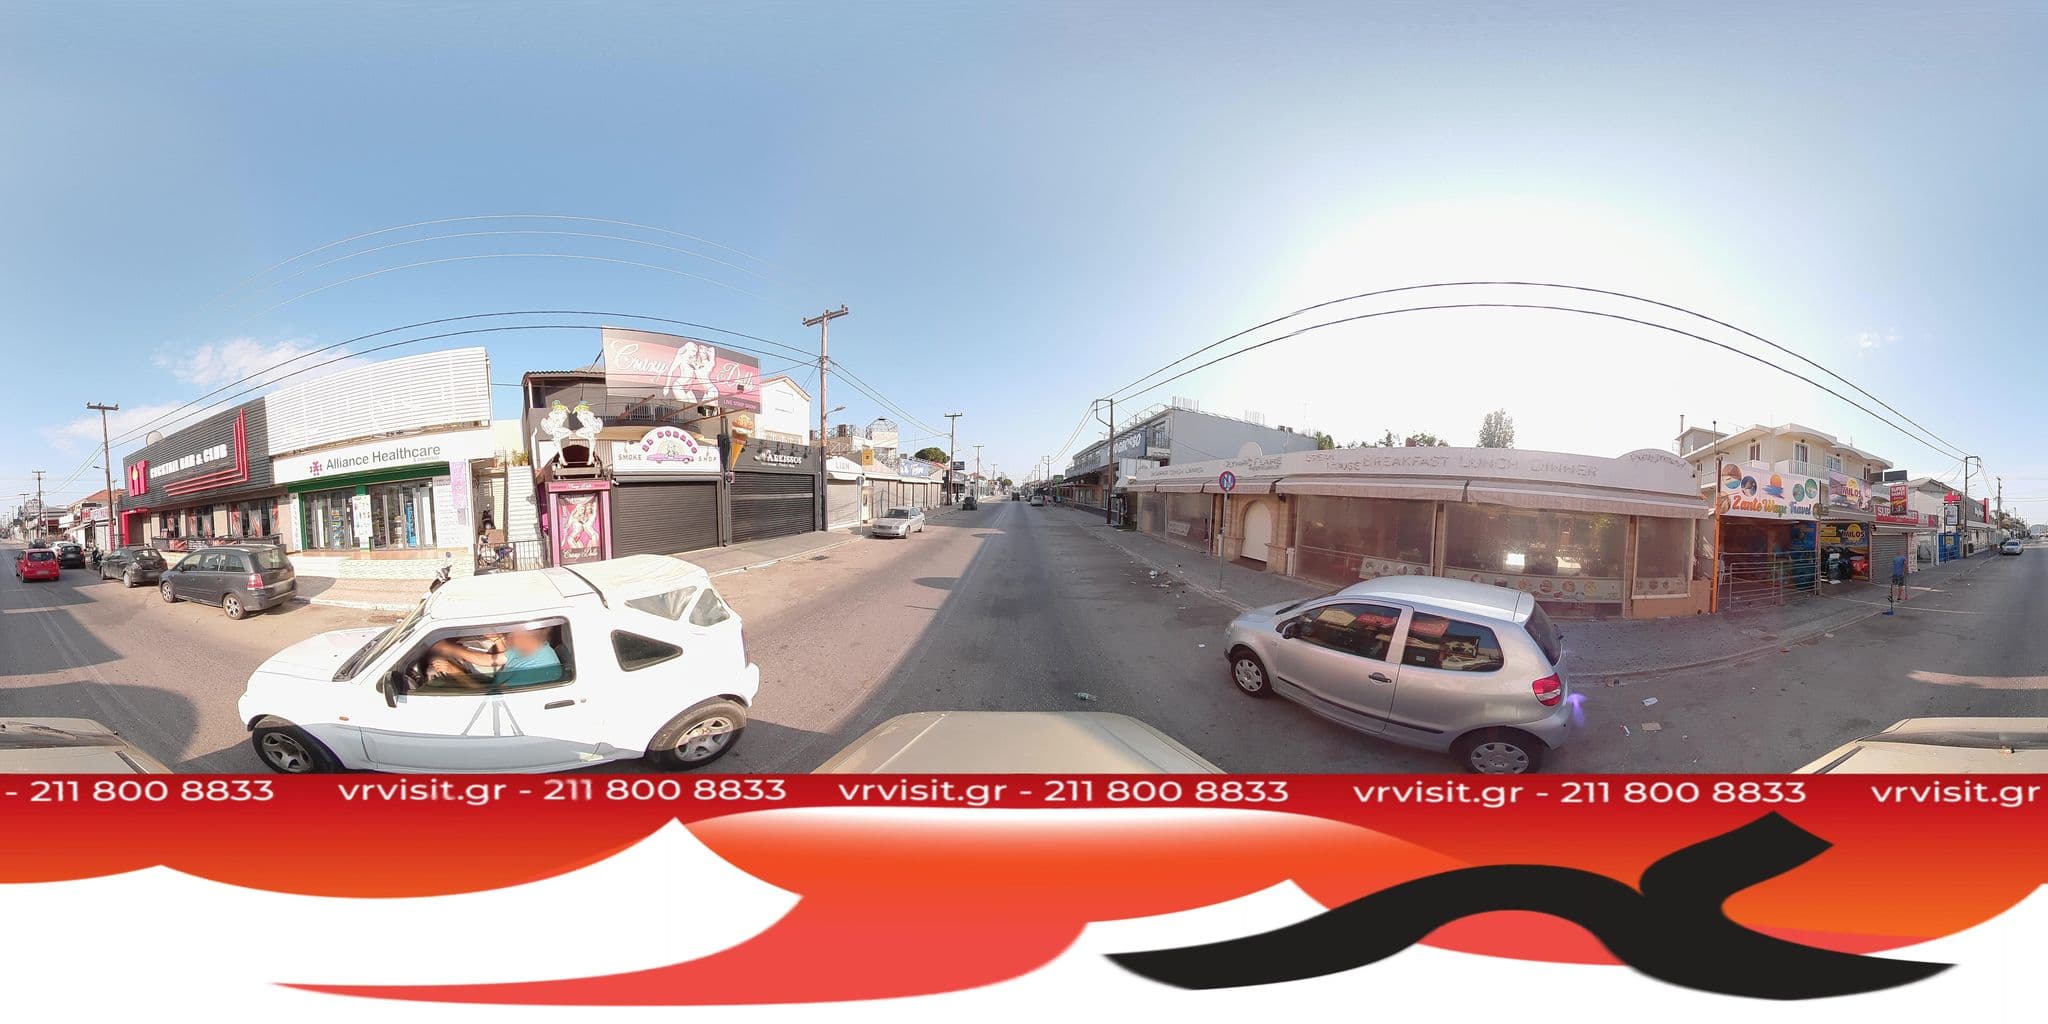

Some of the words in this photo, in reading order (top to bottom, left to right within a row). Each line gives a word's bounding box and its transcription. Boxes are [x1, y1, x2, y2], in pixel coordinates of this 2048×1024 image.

[196, 453, 203, 465] &
[203, 443, 228, 463] CLUB
[326, 455, 369, 470] Alliance
[372, 445, 441, 463] Healthcare
[618, 453, 642, 461] SMOKE
[1362, 455, 1449, 468] BREAKFAST
[1458, 455, 1519, 470] LUNCH
[1732, 495, 1762, 512] Zante
[1789, 501, 1812, 515] Travel
